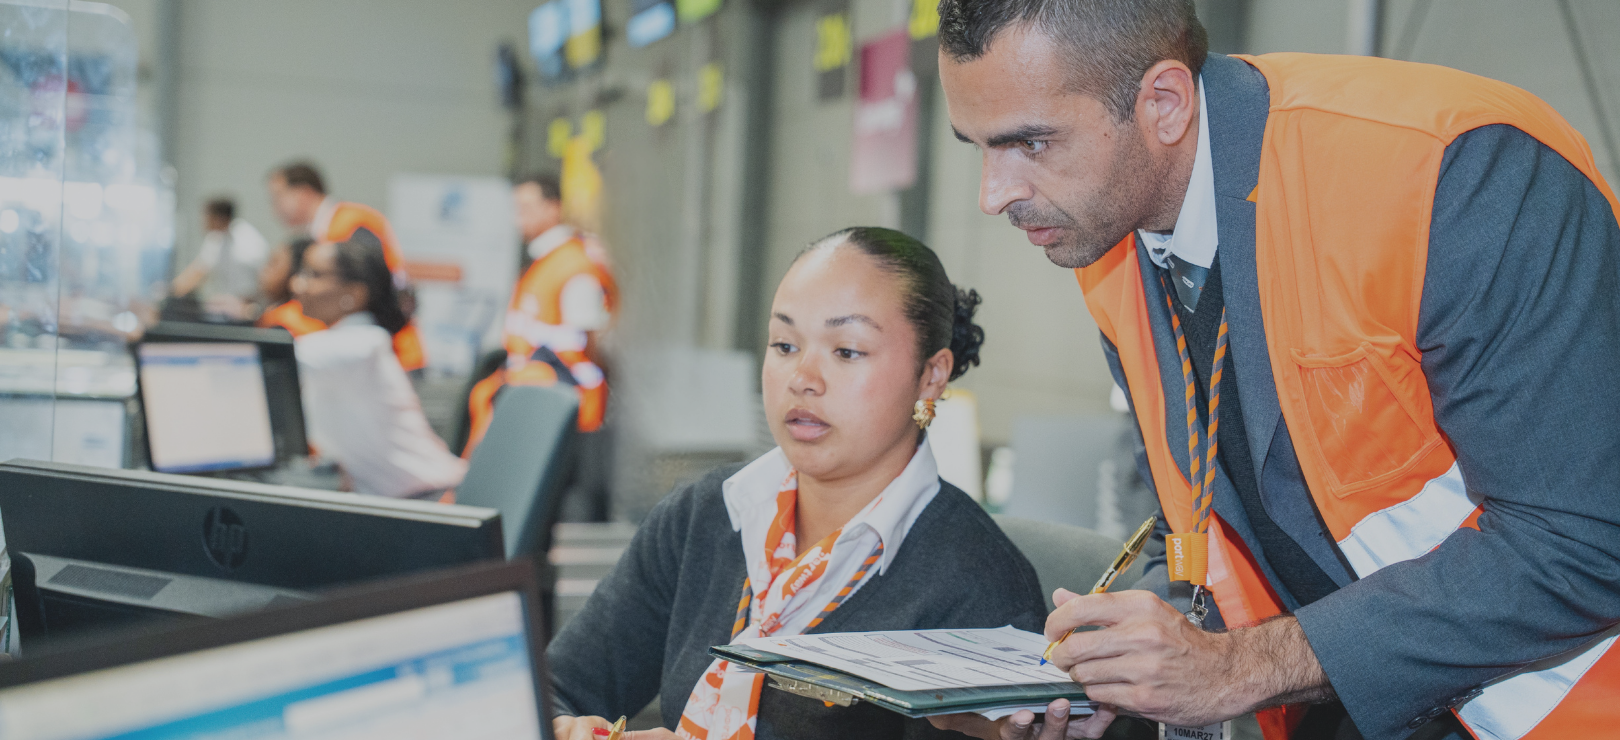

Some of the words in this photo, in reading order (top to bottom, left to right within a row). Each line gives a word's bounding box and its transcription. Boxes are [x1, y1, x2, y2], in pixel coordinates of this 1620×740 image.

[206, 506, 247, 568] hp
[1171, 537, 1185, 577] portway
[790, 551, 832, 594] portway
[1173, 728, 1213, 740] 10MAR27
